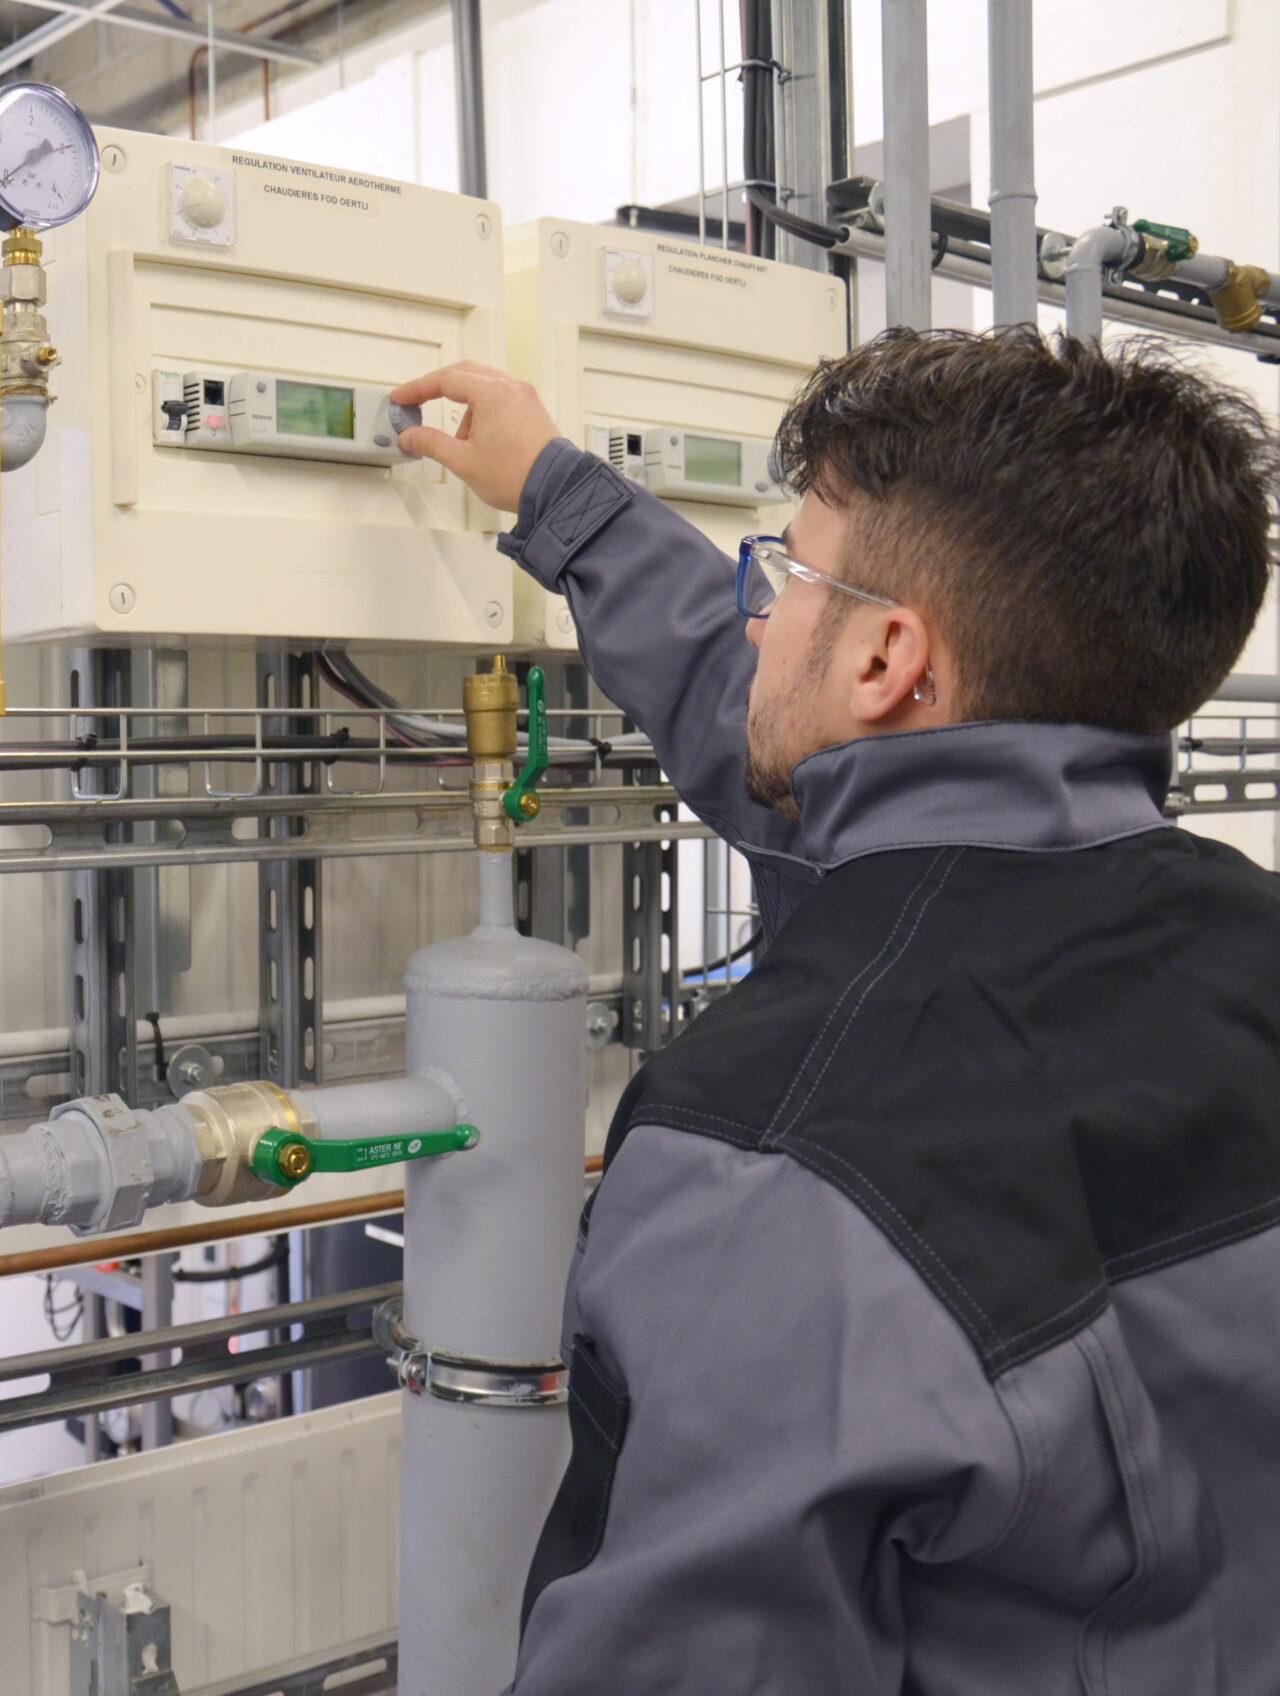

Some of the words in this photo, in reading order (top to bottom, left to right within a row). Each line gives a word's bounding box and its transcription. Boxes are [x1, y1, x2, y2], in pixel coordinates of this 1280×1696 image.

[232, 155, 288, 172] REGULATION
[290, 166, 347, 183] VENTILATEUR
[348, 177, 402, 195] AEROTHERME
[264, 184, 319, 201] CHAUDIERES
[320, 193, 338, 205] FOD
[340, 197, 369, 210] OERTLI
[657, 244, 698, 259] REGULATION
[700, 252, 732, 265] PLANCHER
[668, 265, 709, 280] CHAUDIERES
[370, 1143, 392, 1155] ASTER
[393, 1141, 403, 1150] NF
